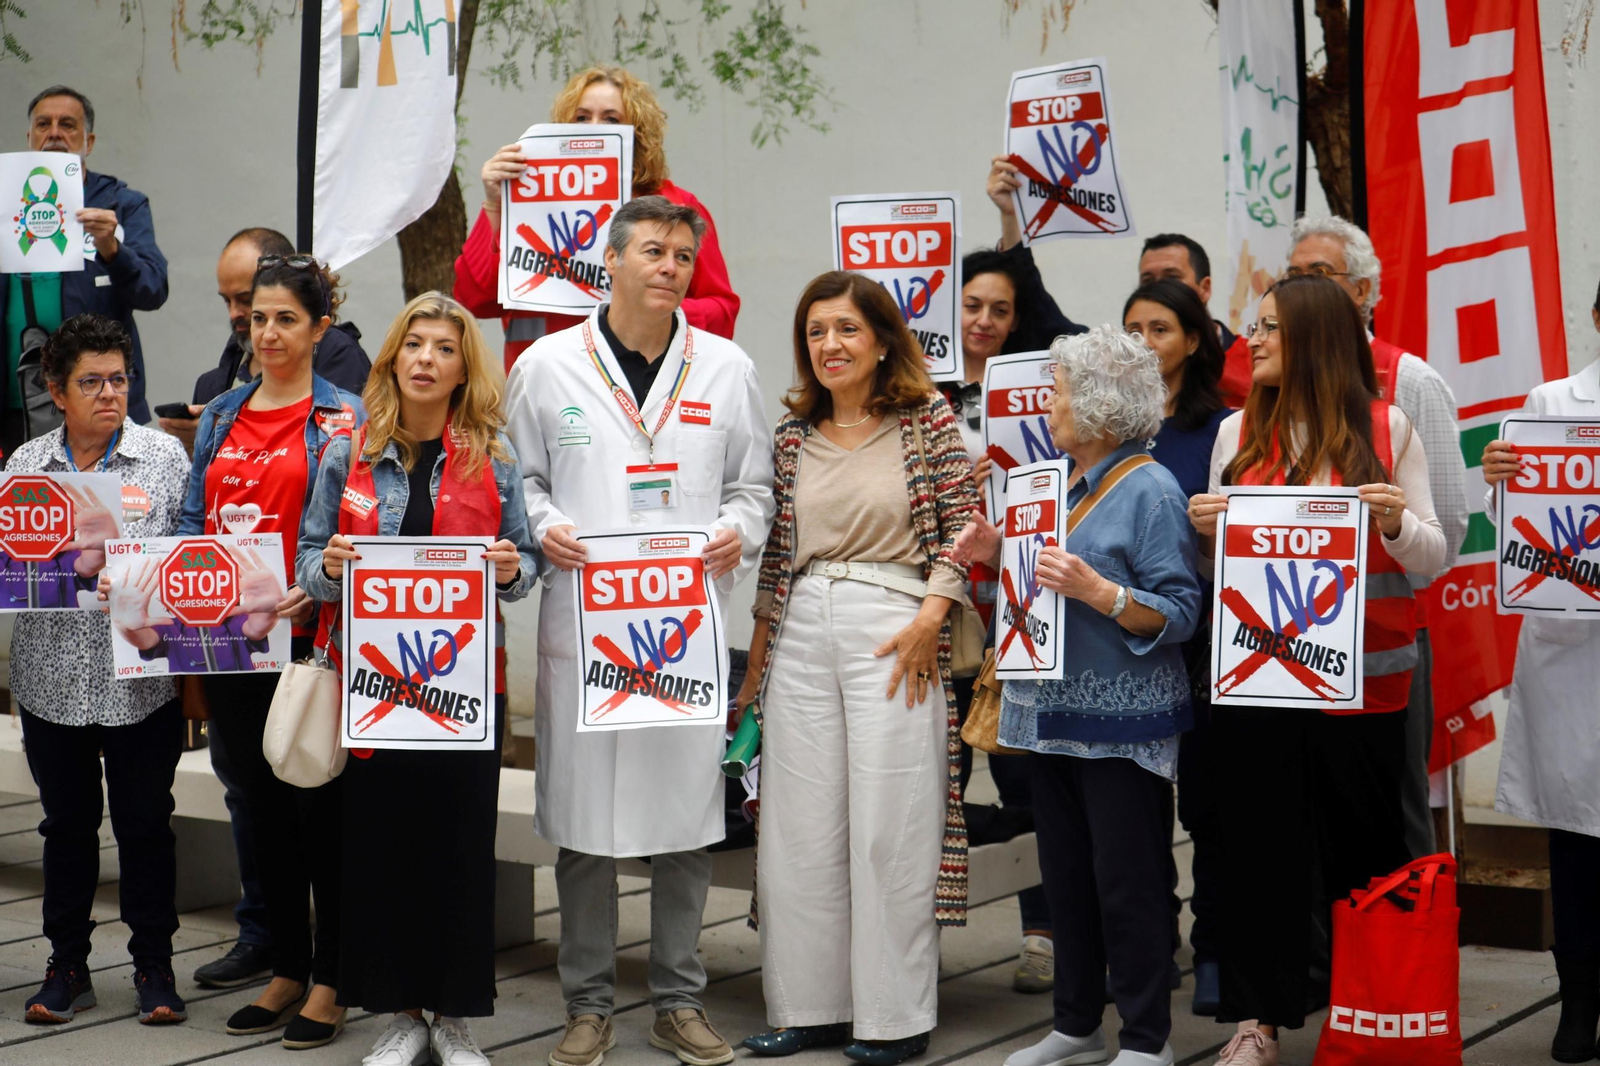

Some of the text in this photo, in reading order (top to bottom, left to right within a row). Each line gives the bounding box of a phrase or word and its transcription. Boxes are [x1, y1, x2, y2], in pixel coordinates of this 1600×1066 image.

[1027, 96, 1081, 123] STOP
[1036, 121, 1101, 187] NO
[518, 165, 607, 198] STOP
[903, 205, 929, 213] CCOO
[1028, 178, 1116, 214] AGRESIONES
[32, 210, 56, 220] STOP
[547, 209, 597, 261] NO
[848, 230, 941, 265] STOP
[681, 406, 711, 418] CCOO
[1007, 386, 1055, 413] STO
[1018, 416, 1066, 463] N
[222, 475, 242, 487] con
[1516, 454, 1600, 489] STO
[12, 487, 50, 503] SAS
[1310, 503, 1340, 511] CCOO
[0, 506, 64, 531] STOP
[227, 514, 246, 523] UGT
[1015, 503, 1041, 533] STOP
[4, 533, 61, 541] AGRESIONES
[108, 544, 131, 554] UGT
[236, 538, 252, 546] UGT
[652, 539, 680, 548] CCOO
[1251, 527, 1331, 555] STOP
[182, 552, 216, 568] SAS
[428, 551, 457, 559] CCOO
[169, 570, 230, 598] STOP
[362, 577, 470, 613] STOP
[591, 566, 694, 605] STOP
[1264, 559, 1345, 635] NO
[174, 598, 227, 608] AGRESIONES
[397, 629, 458, 685] NO
[627, 616, 687, 674] NO
[1232, 622, 1347, 677] AGRESIONES
[118, 666, 134, 675] UGT
[253, 661, 269, 669] UGT
[350, 667, 481, 724] AGRESIONES
[586, 660, 714, 707] AGRESIONES
[1330, 1005, 1427, 1038] CCOO
